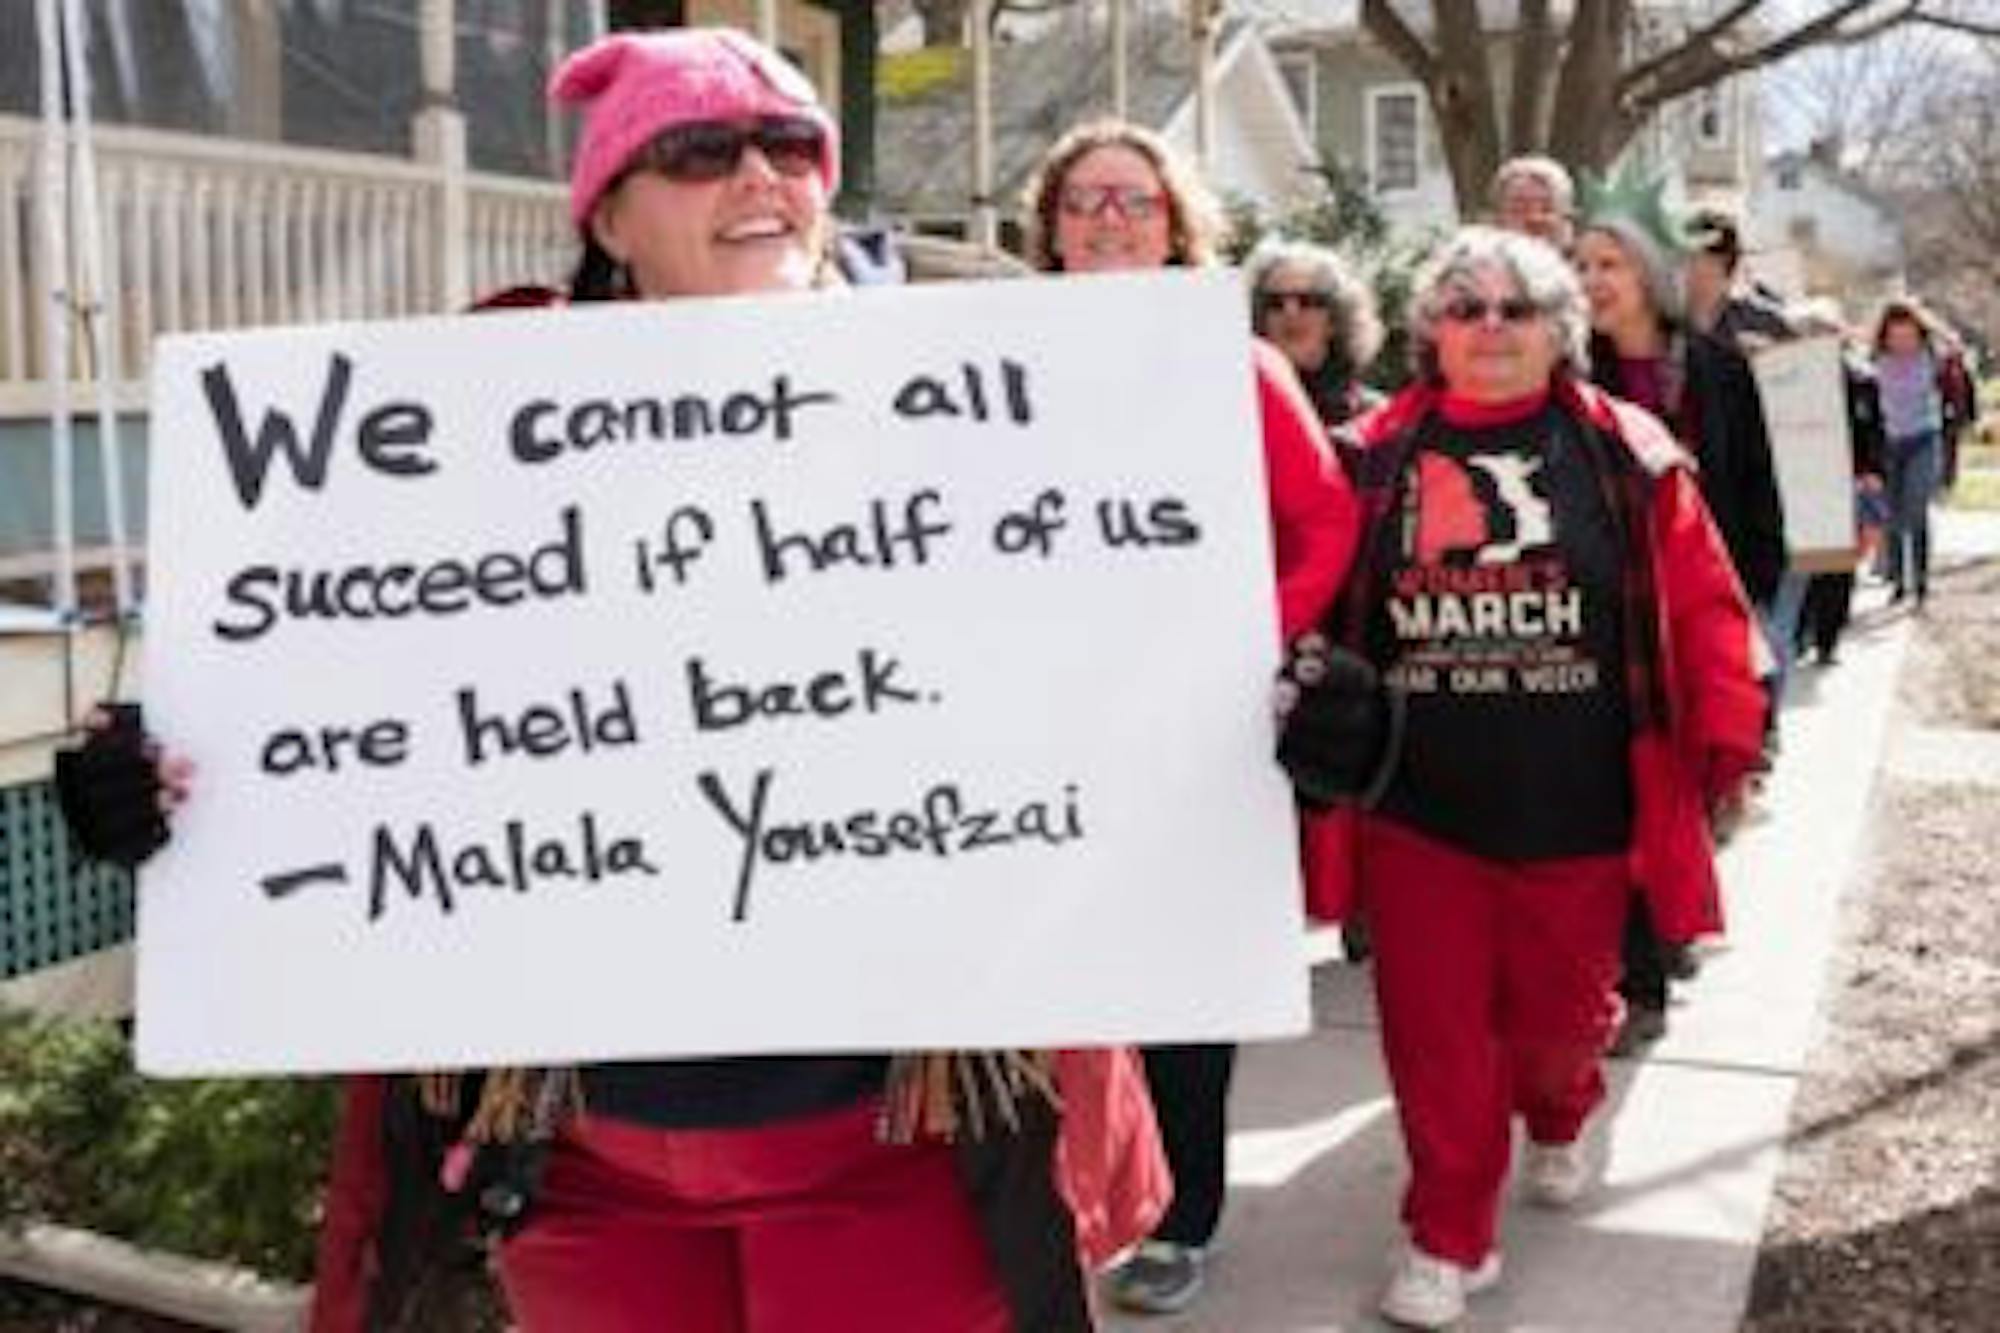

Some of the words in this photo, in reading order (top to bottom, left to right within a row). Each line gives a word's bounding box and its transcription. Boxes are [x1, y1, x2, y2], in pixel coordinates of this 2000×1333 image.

[203, 354, 438, 509] We
[510, 377, 831, 463] cannot
[893, 361, 1031, 424] all
[214, 506, 586, 641] succeed
[638, 508, 713, 592] if
[752, 490, 949, 582] half
[994, 490, 1064, 555] of
[1098, 500, 1199, 546] us
[1388, 588, 1582, 640] MARCH
[261, 721, 408, 776] are
[458, 682, 638, 765] held
[687, 651, 941, 730] back.
[698, 771, 1083, 921] Yousefzai
